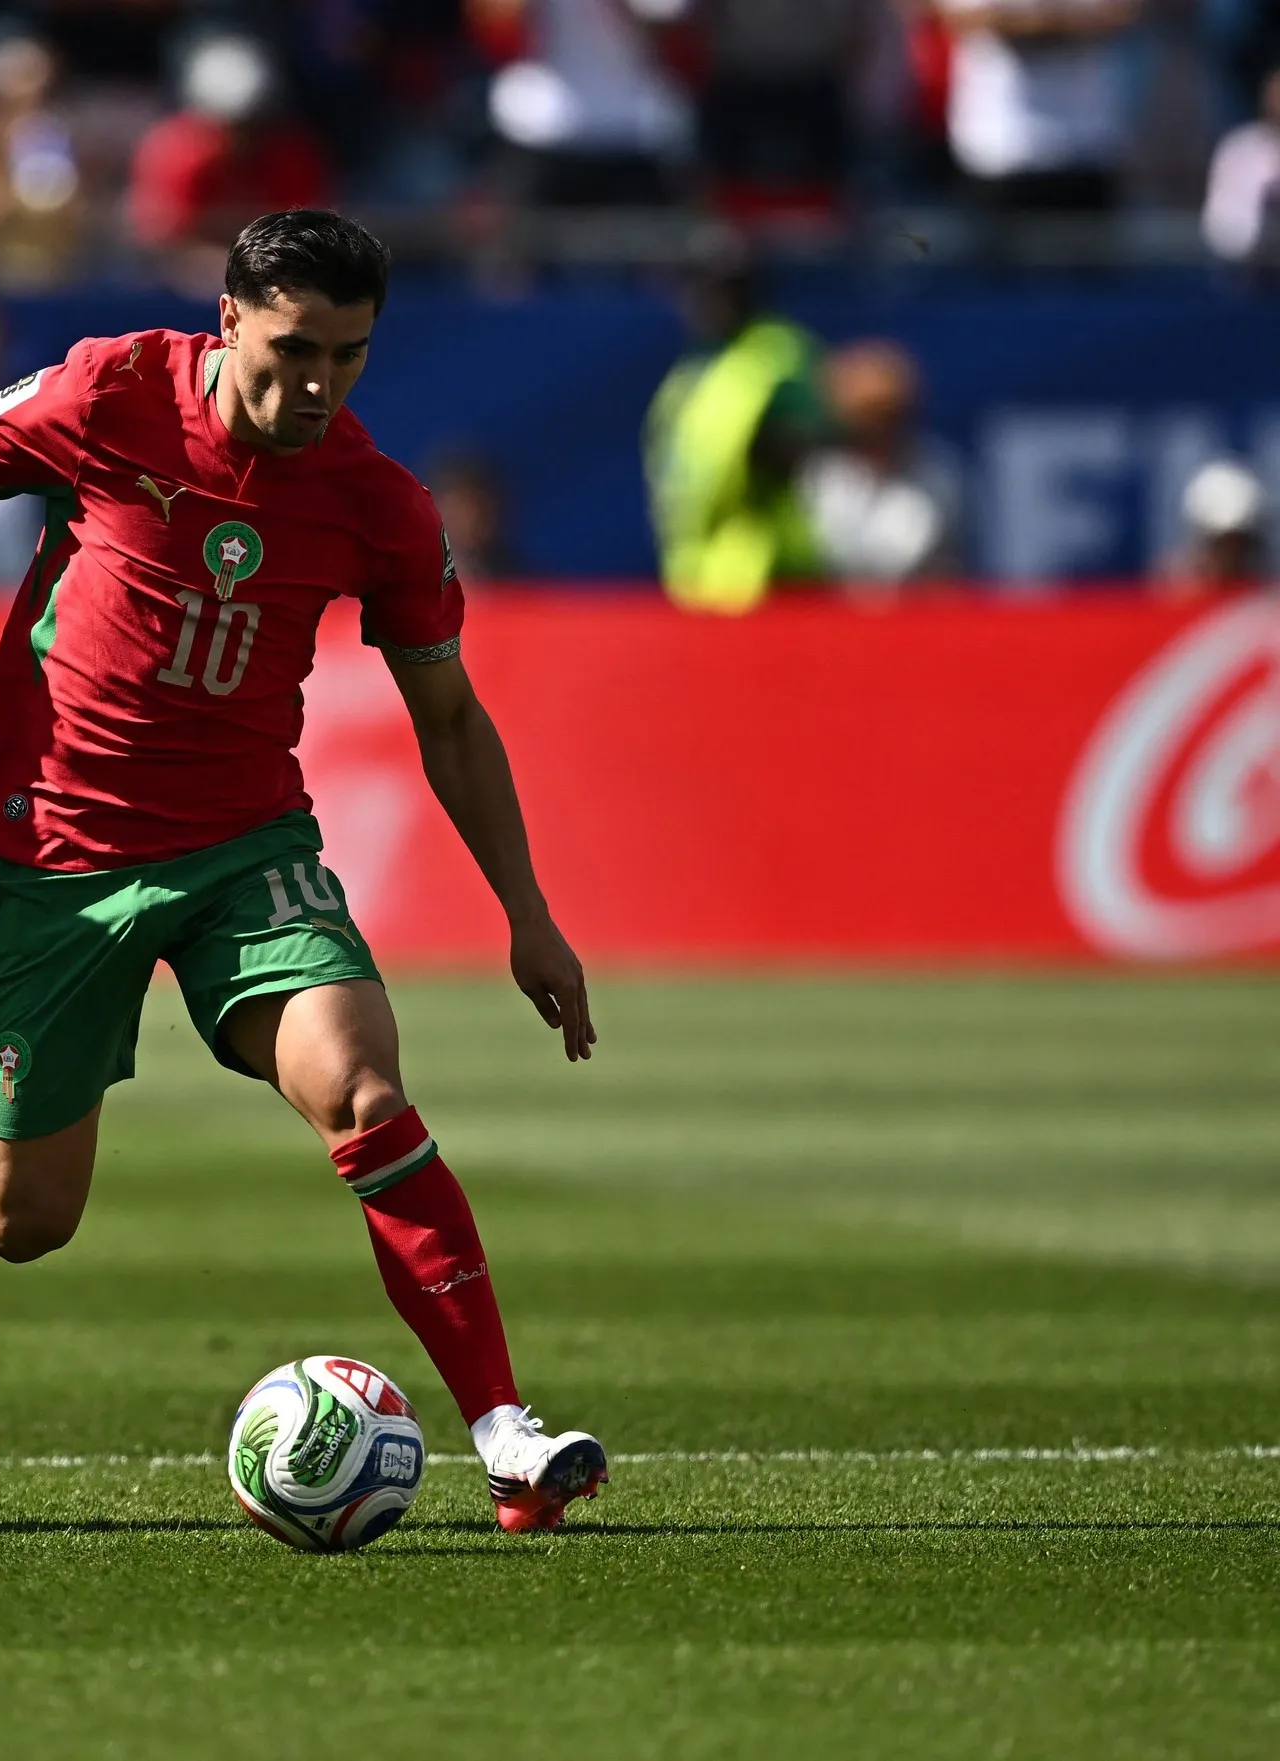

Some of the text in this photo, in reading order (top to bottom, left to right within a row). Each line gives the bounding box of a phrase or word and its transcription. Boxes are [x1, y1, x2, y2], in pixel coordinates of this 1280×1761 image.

[156, 589, 261, 696] 10
[263, 863, 340, 929] 10
[314, 1422, 350, 1476] TRIONDA
[383, 1452, 391, 1468] FIFA
